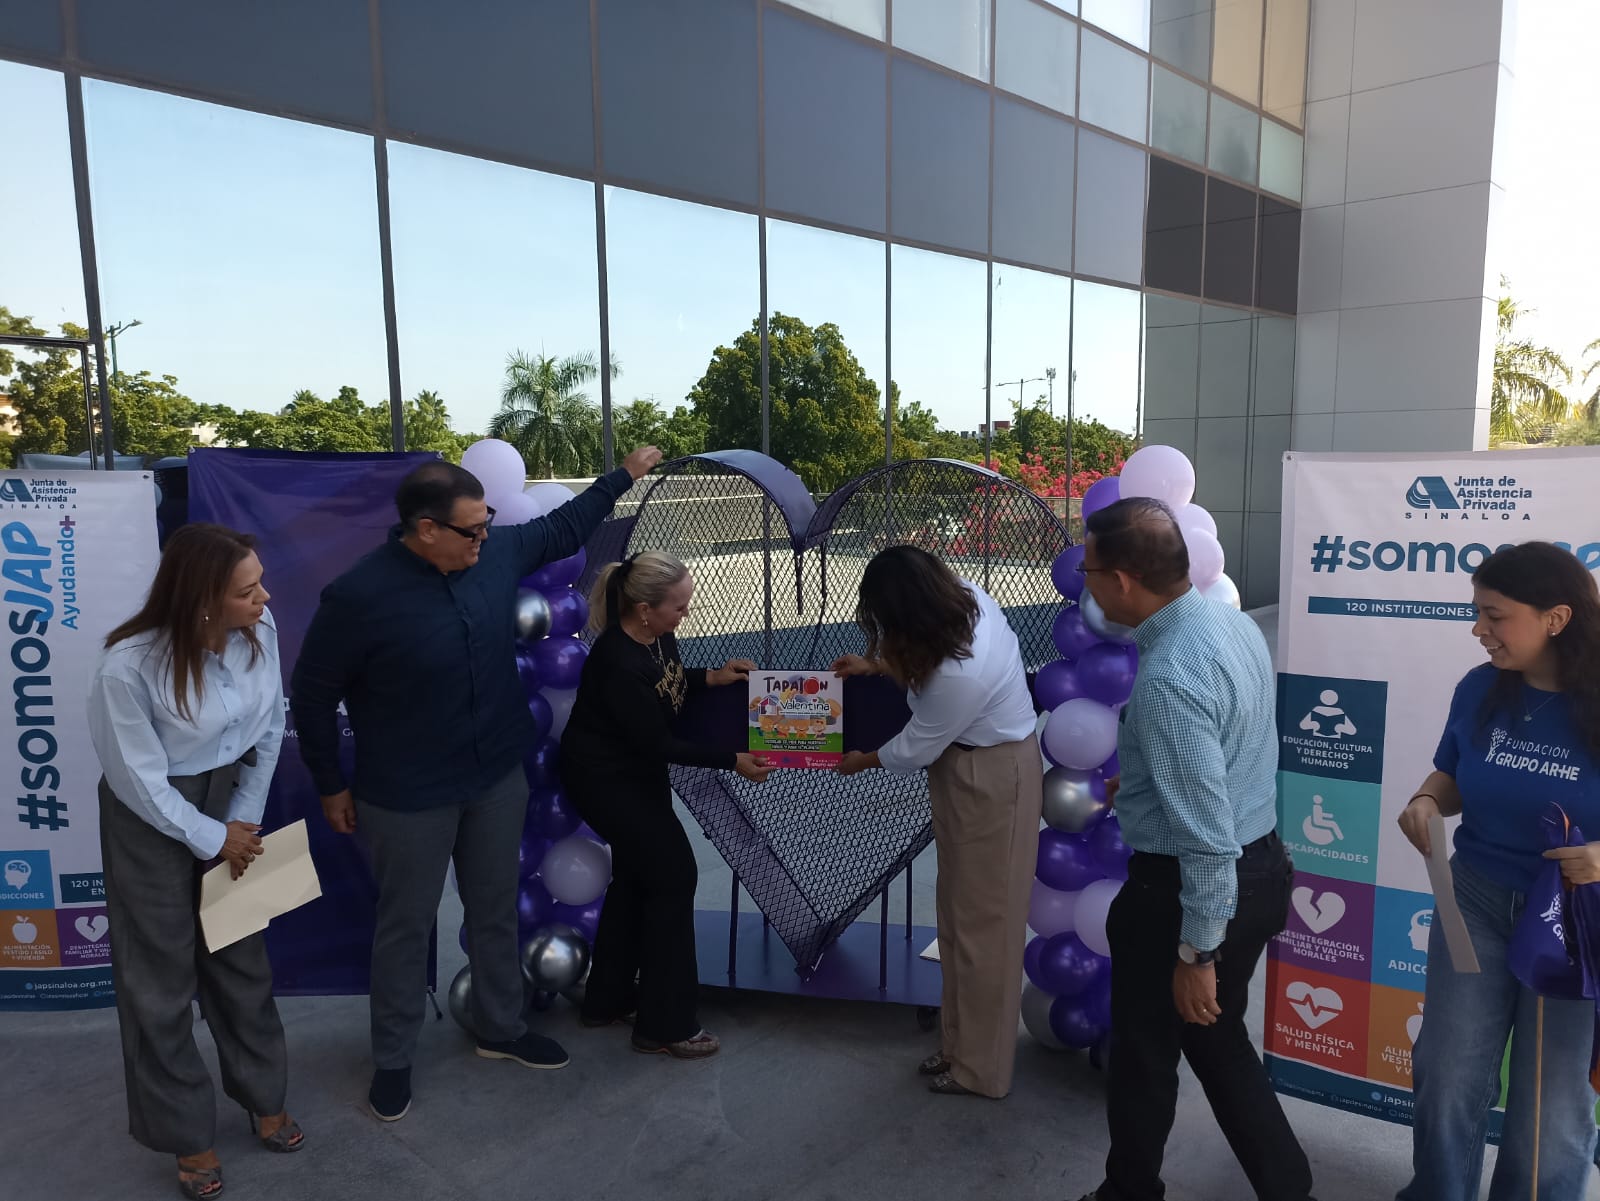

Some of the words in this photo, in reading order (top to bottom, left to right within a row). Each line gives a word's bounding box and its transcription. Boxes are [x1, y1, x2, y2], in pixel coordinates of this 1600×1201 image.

[30, 479, 54, 487] Junta
[56, 479, 67, 487] de
[1454, 476, 1494, 487] Junta
[1498, 476, 1516, 487] de
[35, 495, 68, 503] Privada
[1457, 488, 1532, 499] Asistencia
[1463, 499, 1516, 510] Privada
[1405, 512, 1531, 521] SINALOA
[1345, 602, 1368, 613] 120
[1371, 603, 1474, 618] INSTITUCIONES
[780, 698, 830, 711] Valentina
[1296, 746, 1302, 754] Y
[1303, 748, 1355, 761] DERECHOS
[1333, 743, 1373, 754] CULTURA
[1301, 756, 1349, 770] HUMANOS
[1495, 751, 1539, 772] GRUPO
[1283, 841, 1369, 864] SCAPACIDADES
[71, 880, 89, 888] 120
[1272, 934, 1312, 950] AMILIAR
[1314, 944, 1320, 952] Y
[1321, 946, 1365, 962] VALORES
[1293, 947, 1337, 963] MORALES
[1388, 959, 1427, 975] ADICC
[1275, 1022, 1312, 1040] SALUD
[1315, 1033, 1355, 1050] FÍSICA
[1285, 1036, 1292, 1046] Y
[1294, 1039, 1342, 1058] MENTAL
